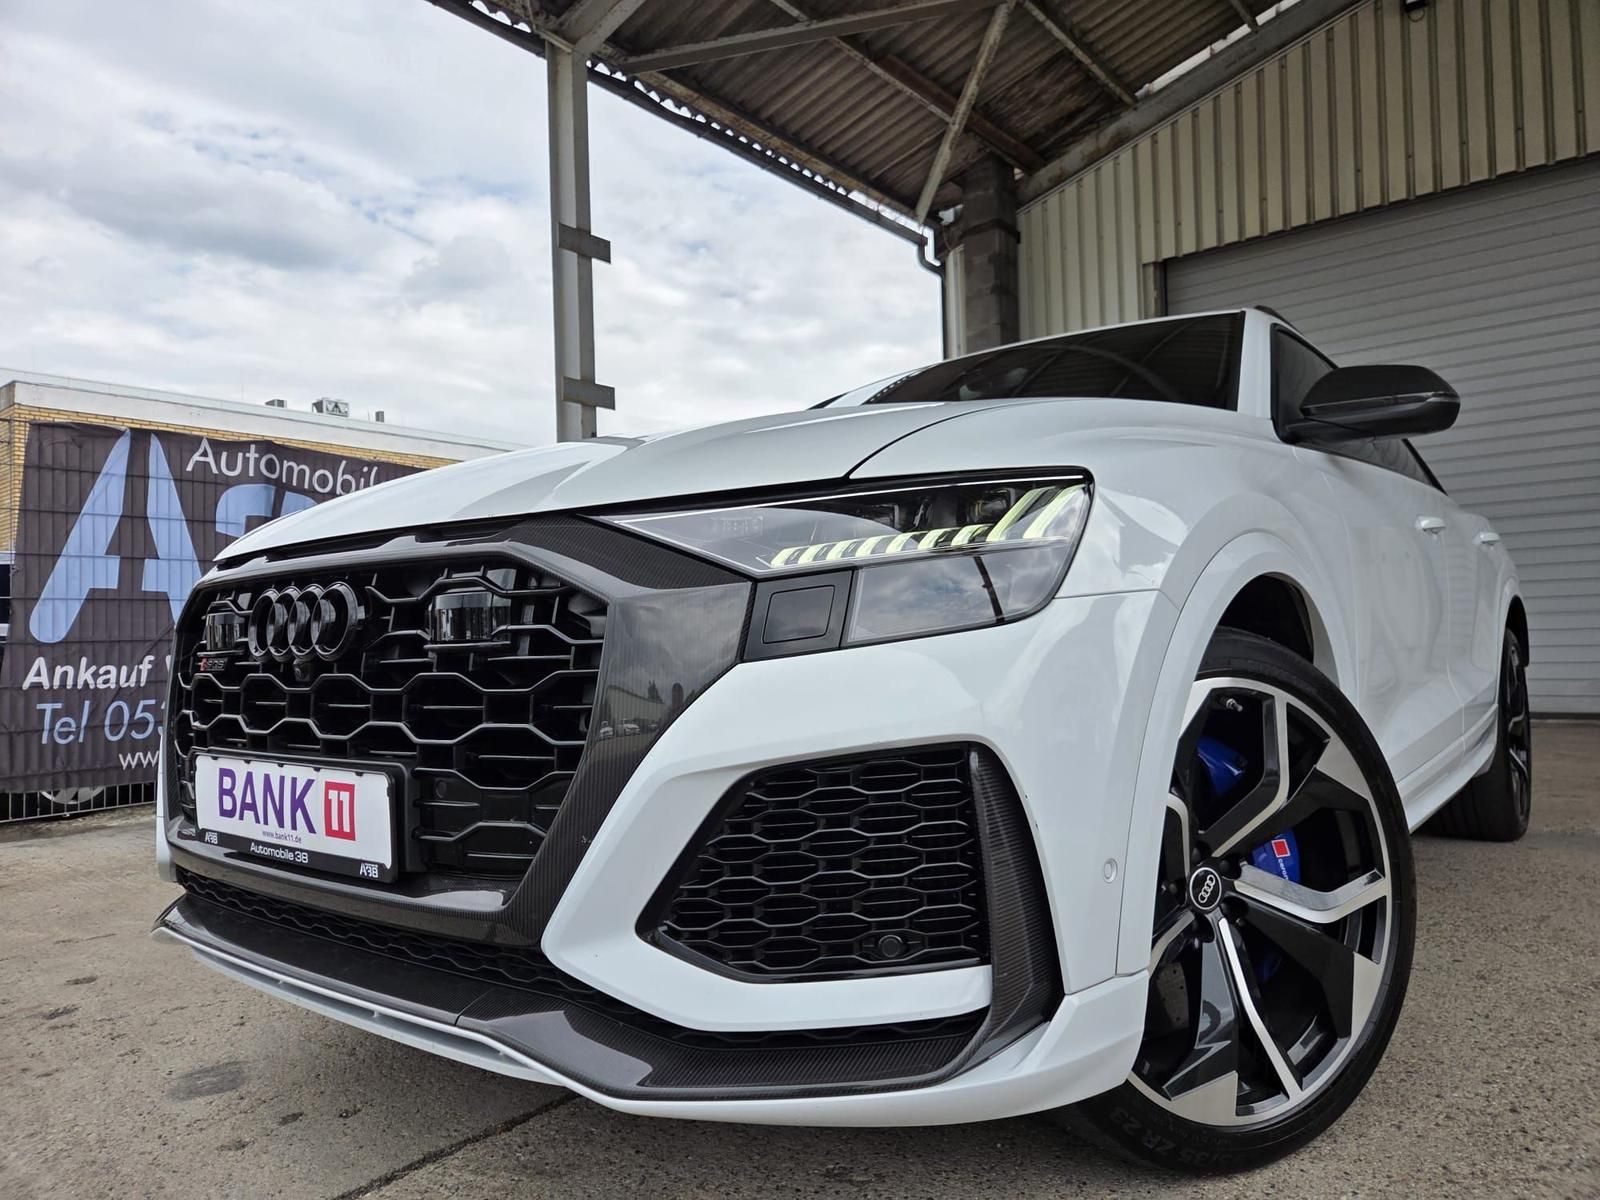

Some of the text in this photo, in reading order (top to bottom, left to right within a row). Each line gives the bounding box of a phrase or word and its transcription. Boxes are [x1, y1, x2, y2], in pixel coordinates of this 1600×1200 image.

[22, 655, 155, 691] Ankauf
[36, 700, 90, 745] Tel
[218, 767, 351, 835] BANK 11
[250, 842, 309, 864] Automobile 38
[262, 830, 302, 844] www.bank11.de
